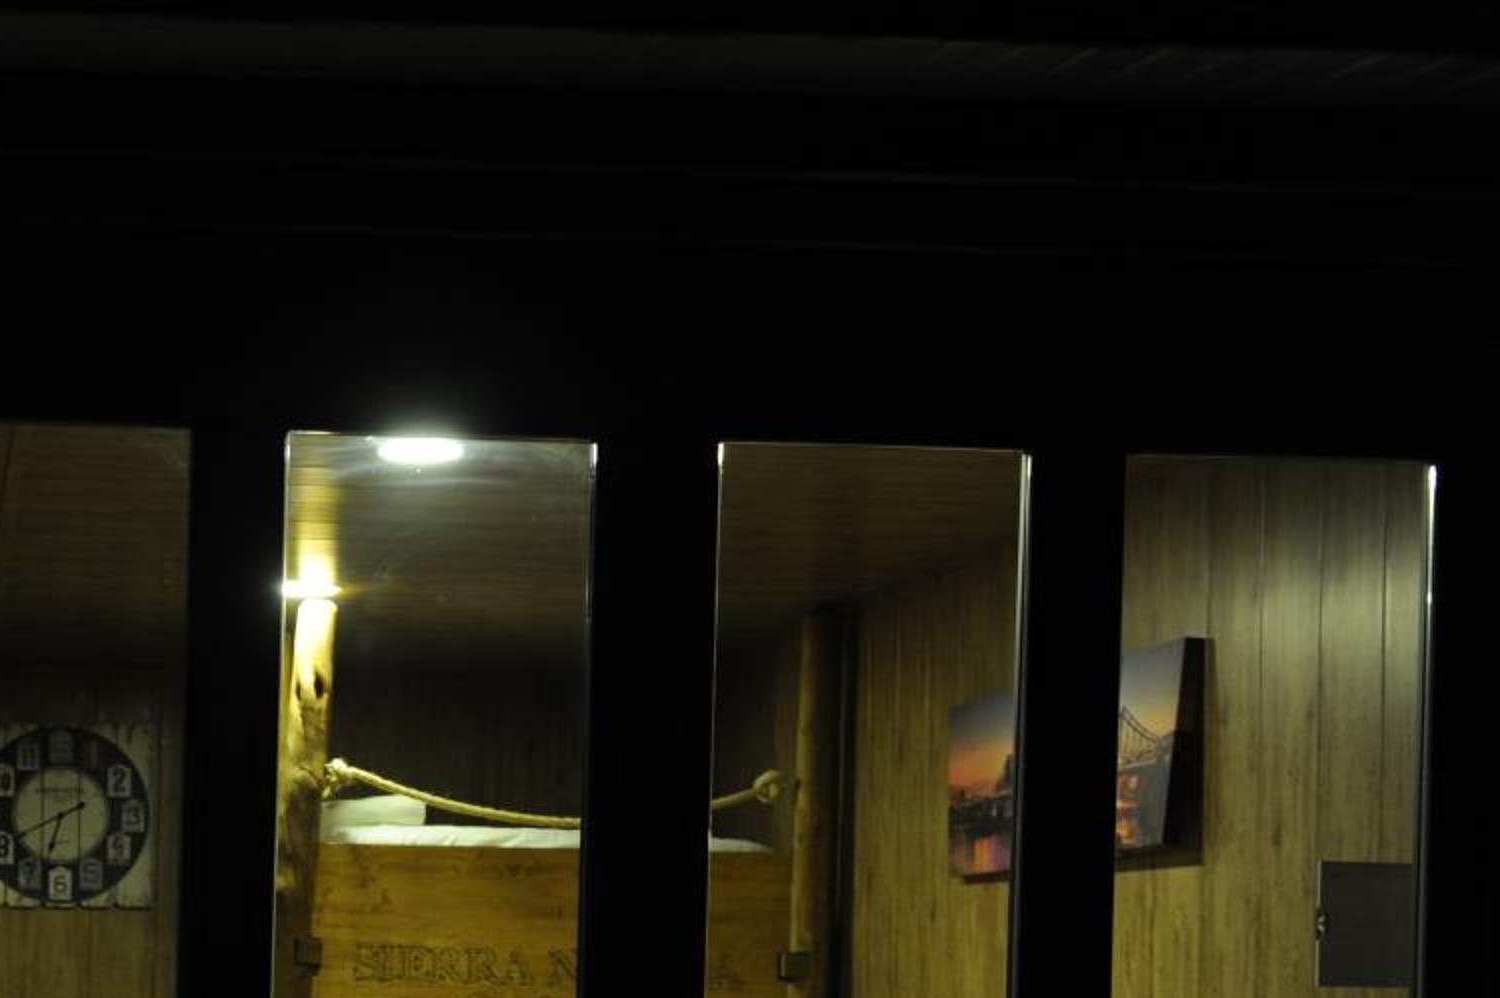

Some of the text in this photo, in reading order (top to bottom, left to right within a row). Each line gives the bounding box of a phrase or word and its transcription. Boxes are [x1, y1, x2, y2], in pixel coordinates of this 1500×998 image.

[112, 768, 126, 793] 2
[53, 873, 67, 894] 6
[353, 943, 533, 987] SIERRA
